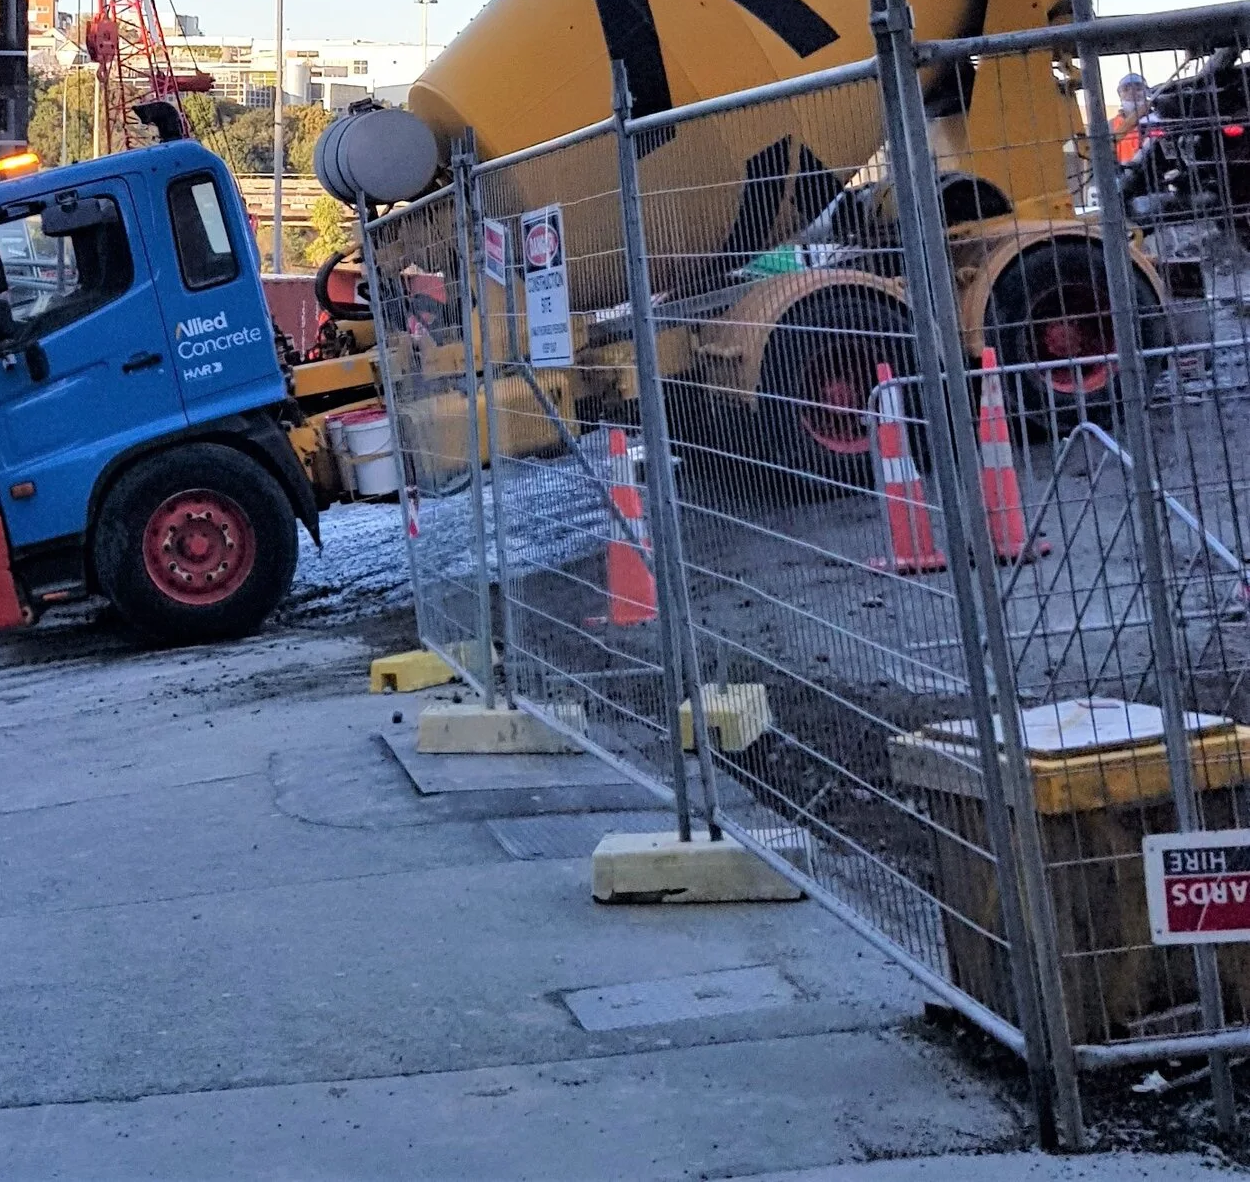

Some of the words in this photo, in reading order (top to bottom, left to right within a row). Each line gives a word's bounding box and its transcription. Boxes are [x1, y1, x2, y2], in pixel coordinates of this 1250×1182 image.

[175, 311, 228, 341] Allied
[178, 326, 262, 359] Concrete
[1170, 850, 1226, 872] HIRE
[1172, 880, 1249, 907] ARDS
